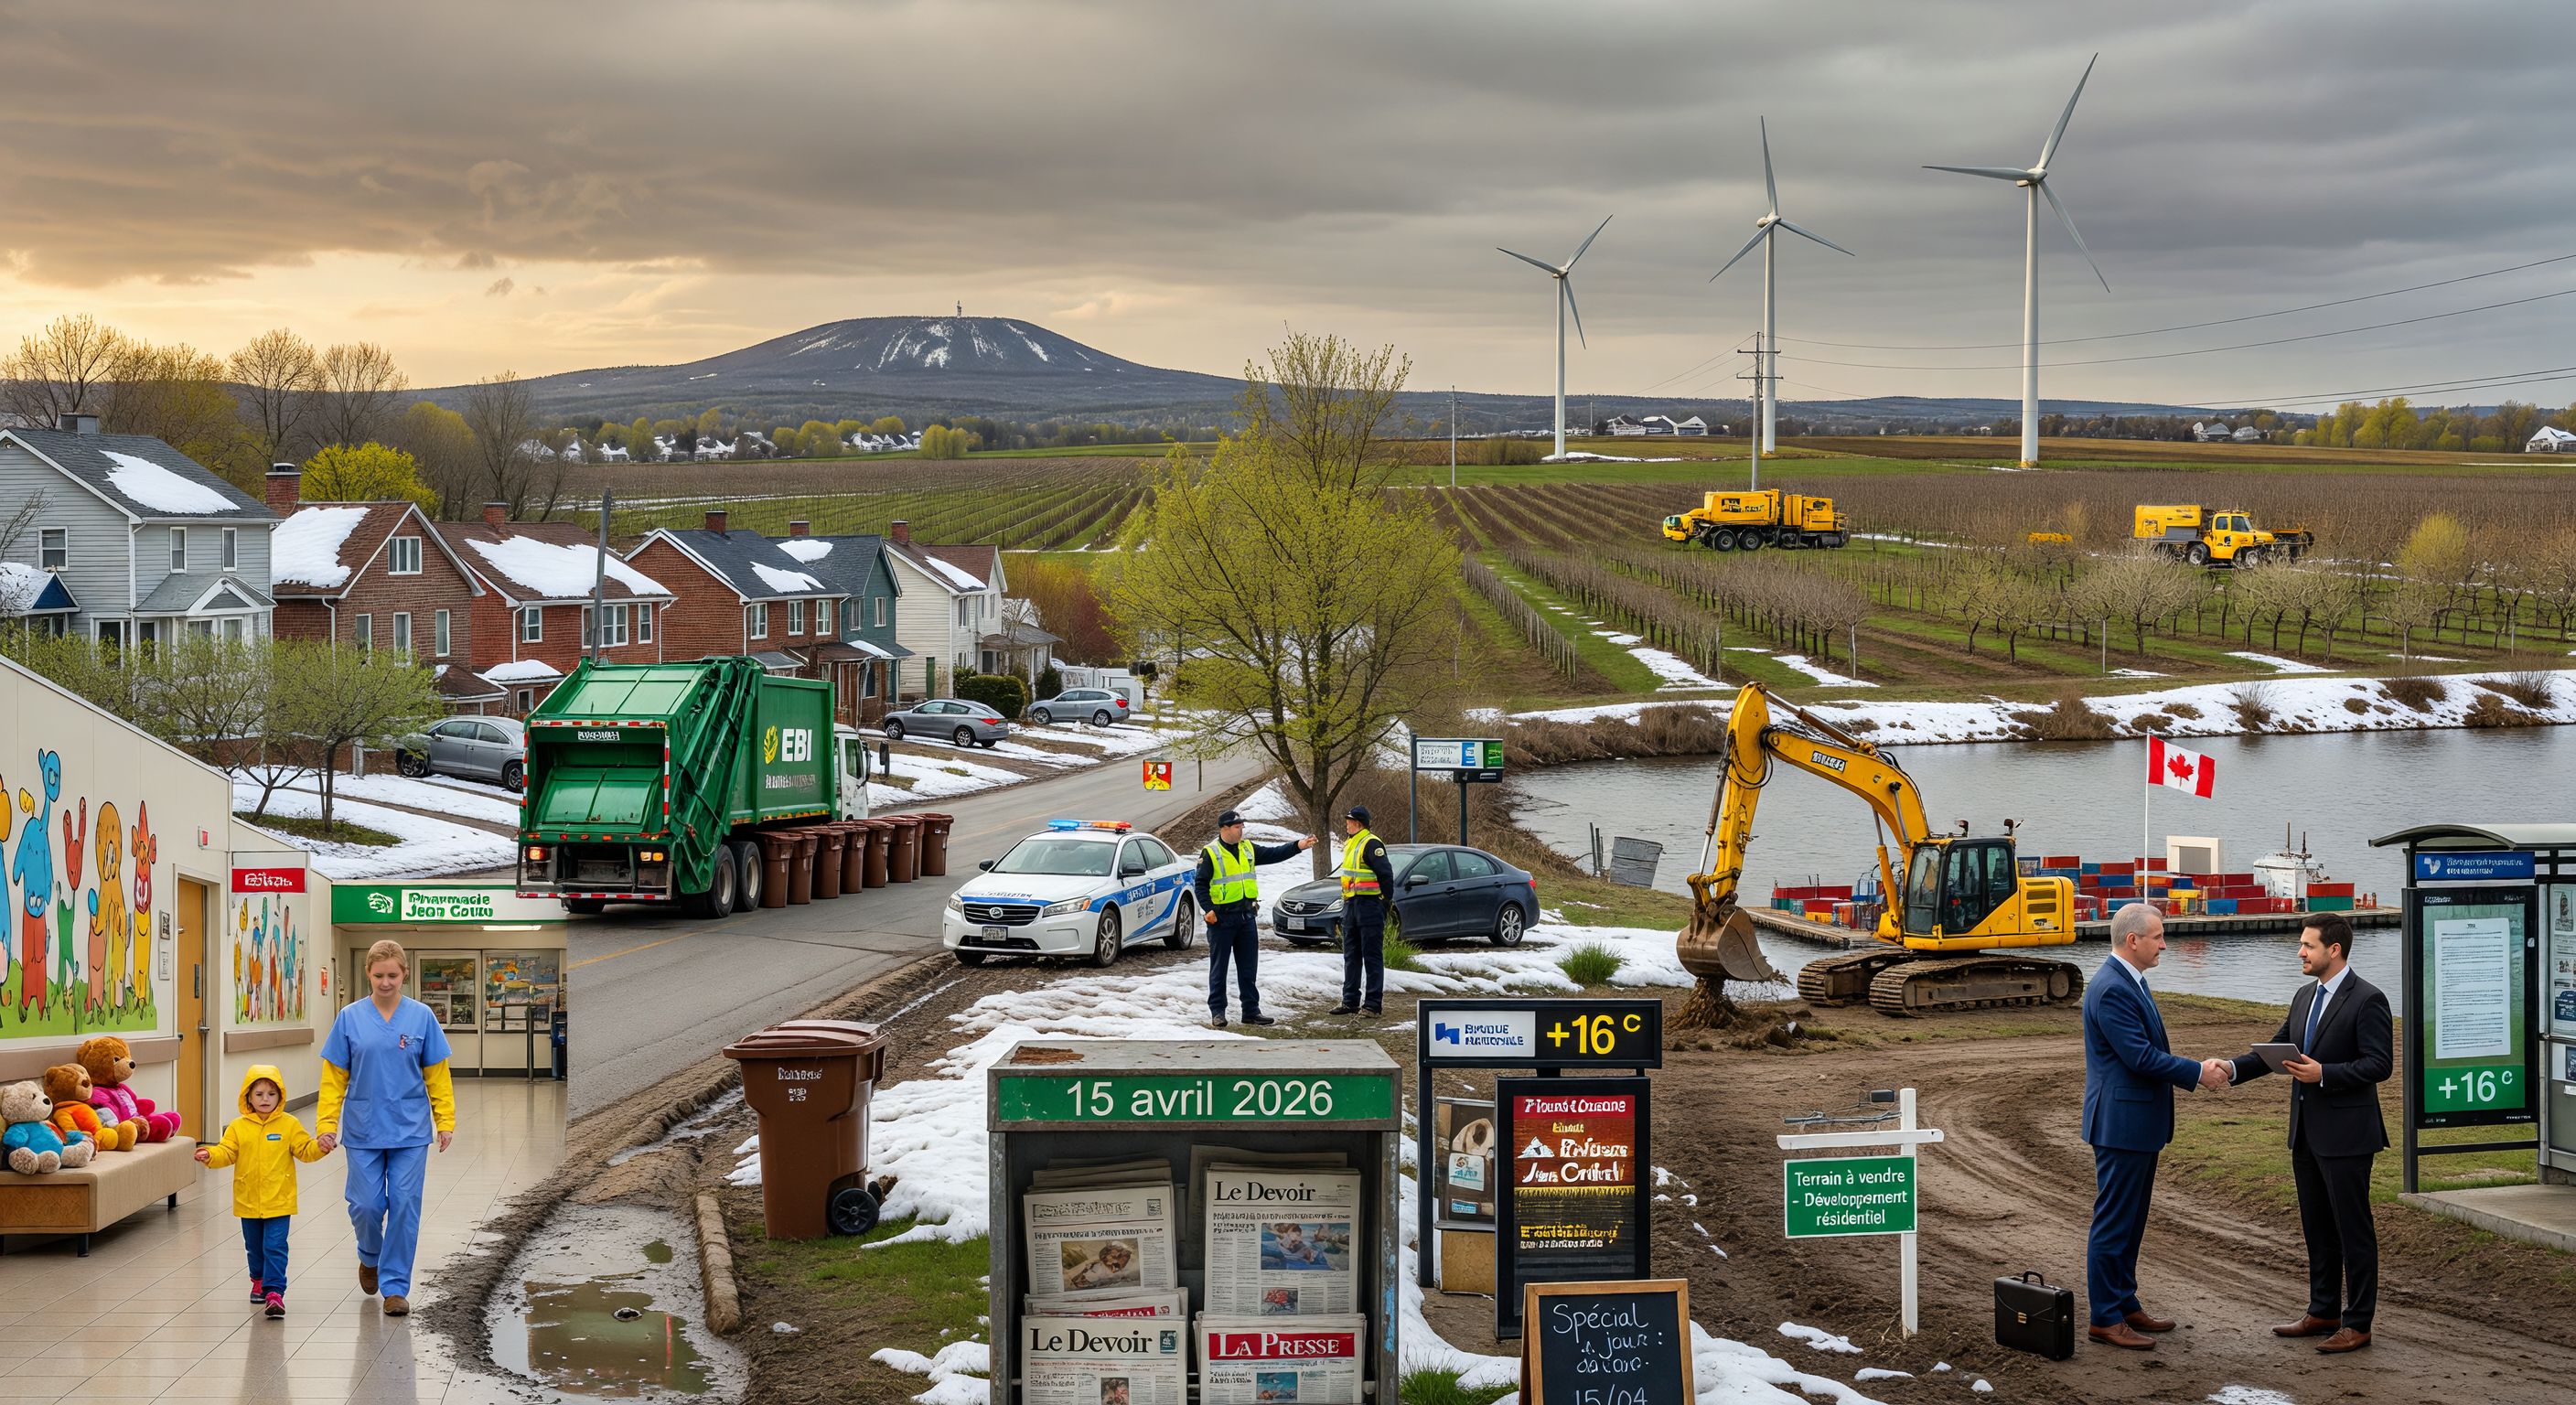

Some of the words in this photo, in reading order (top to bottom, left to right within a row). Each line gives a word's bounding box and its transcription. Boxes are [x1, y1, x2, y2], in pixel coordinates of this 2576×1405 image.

[781, 728, 812, 761] EBI
[1546, 1014, 1615, 1055] +16
[1067, 1080, 1114, 1116] 15
[1131, 1080, 1213, 1116] avril
[1231, 1079, 1333, 1116] 2026
[2438, 1070, 2496, 1102] +16
[1215, 1181, 1241, 1201] Le
[1247, 1182, 1316, 1201] Devoir
[1794, 1171, 1841, 1186] Terrain
[1846, 1169, 1854, 1185] à
[1859, 1167, 1905, 1184] vendre
[1553, 1303, 1648, 1343] Spécial
[1030, 1328, 1063, 1352] Le
[1068, 1328, 1154, 1353] Devoir
